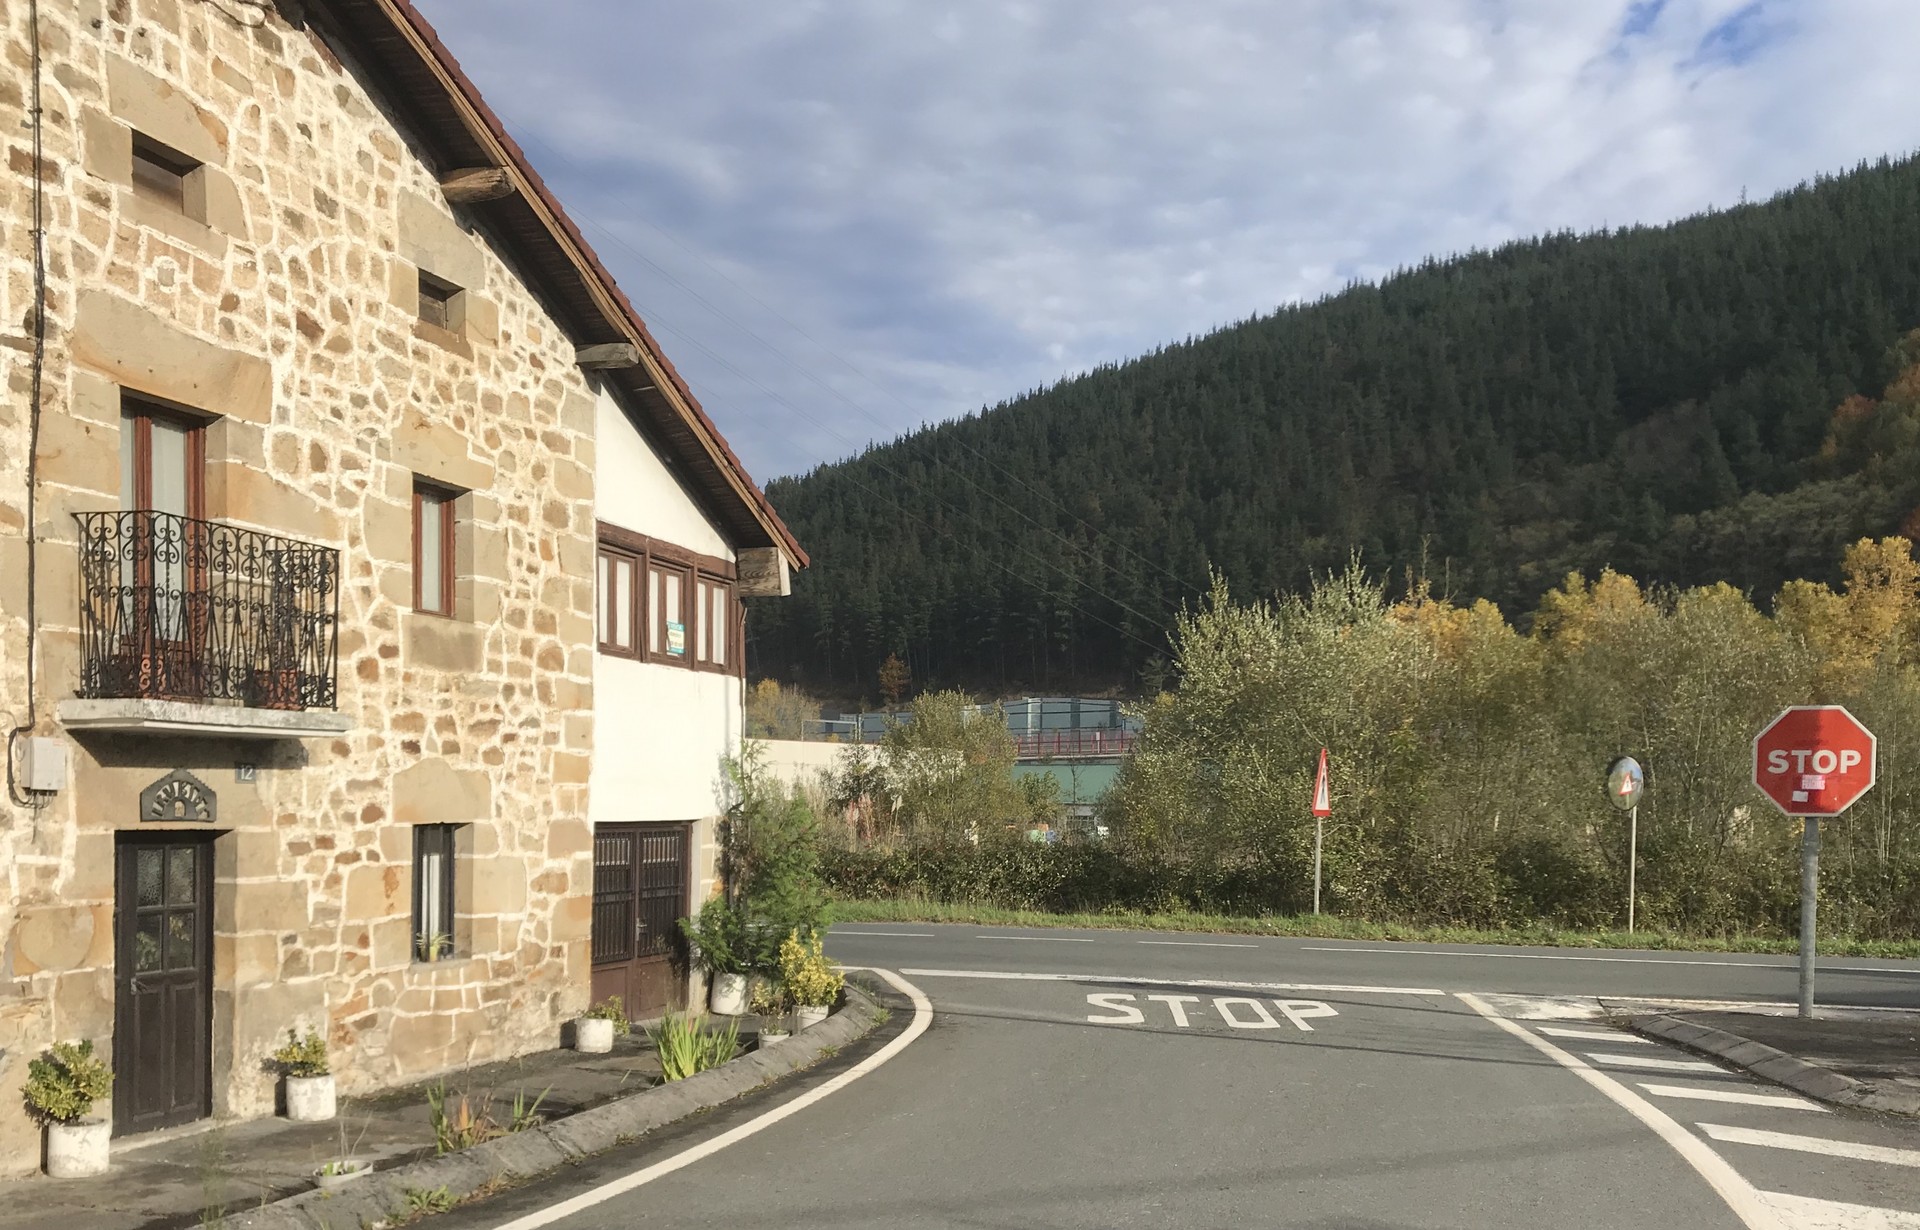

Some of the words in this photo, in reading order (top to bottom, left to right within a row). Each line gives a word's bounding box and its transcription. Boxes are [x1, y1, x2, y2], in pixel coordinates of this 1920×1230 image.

[240, 765, 253, 780] 12
[1767, 749, 1862, 774] STOP
[1086, 993, 1339, 1031] STOP
